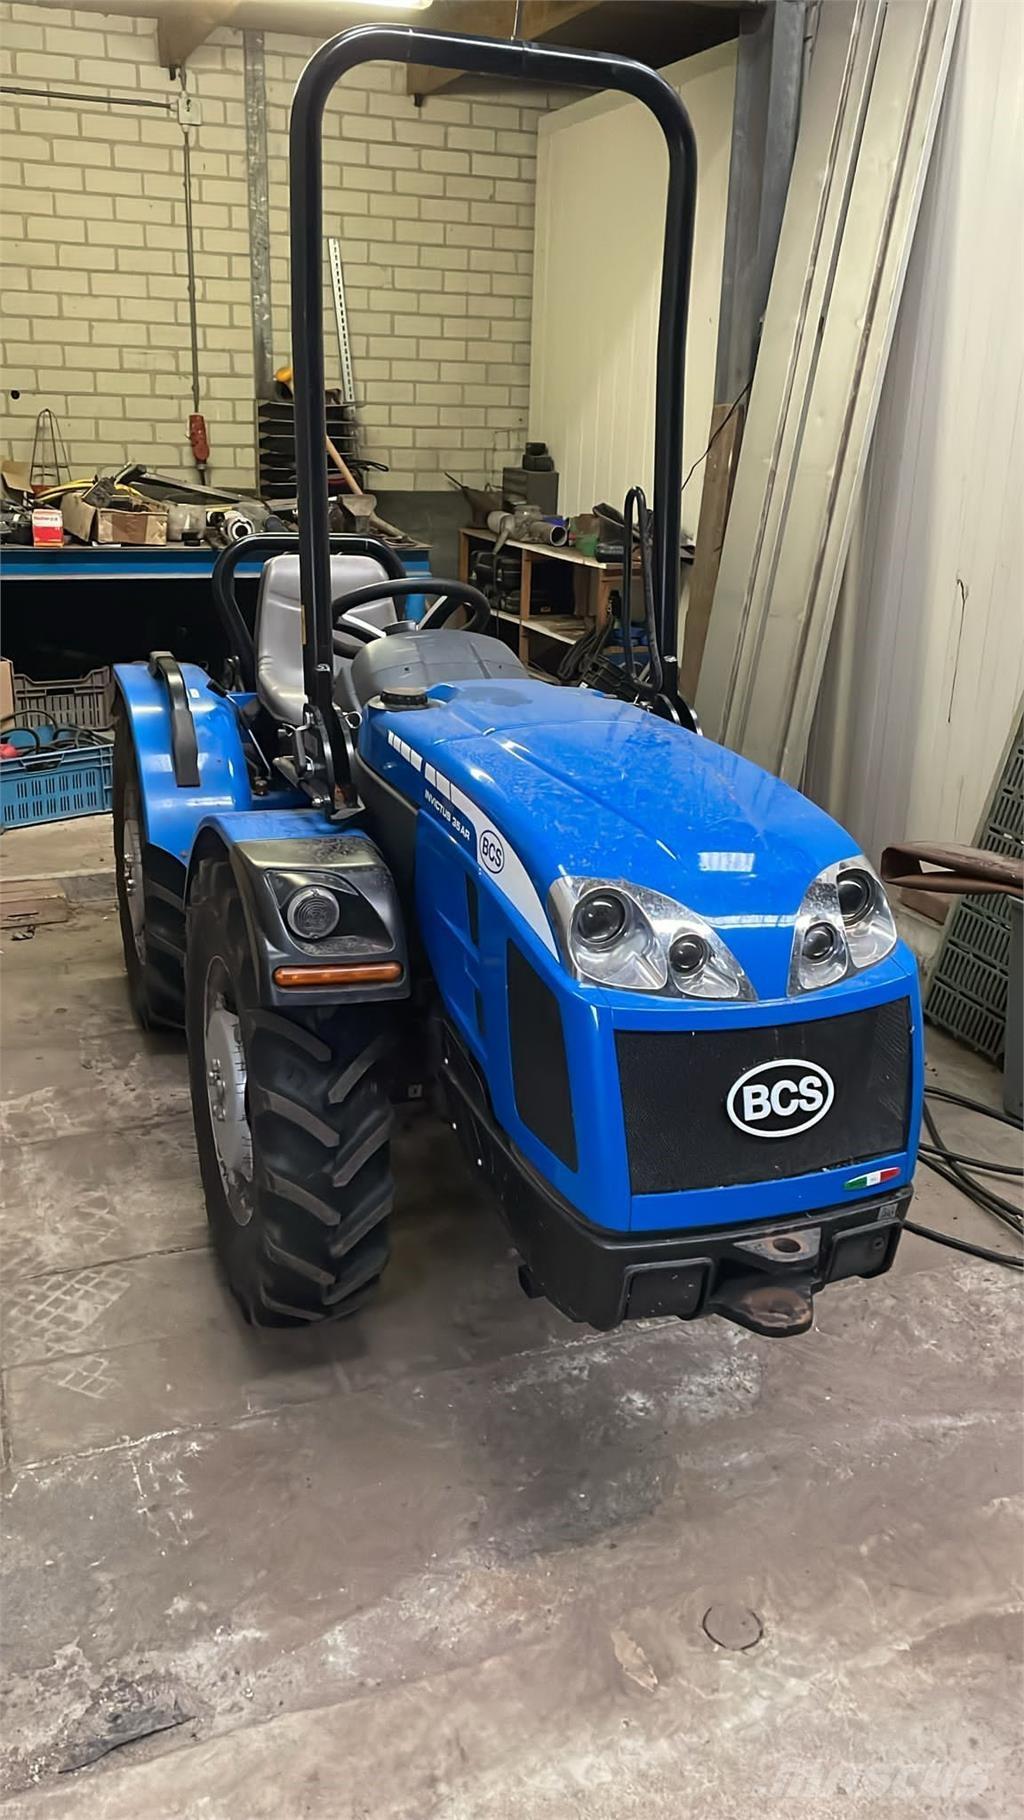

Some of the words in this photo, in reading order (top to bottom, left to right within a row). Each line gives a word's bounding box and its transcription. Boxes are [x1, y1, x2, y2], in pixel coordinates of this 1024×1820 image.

[424, 789, 451, 821] INVICTUS
[482, 836, 502, 868] BCS
[742, 1075, 824, 1122] BCS
